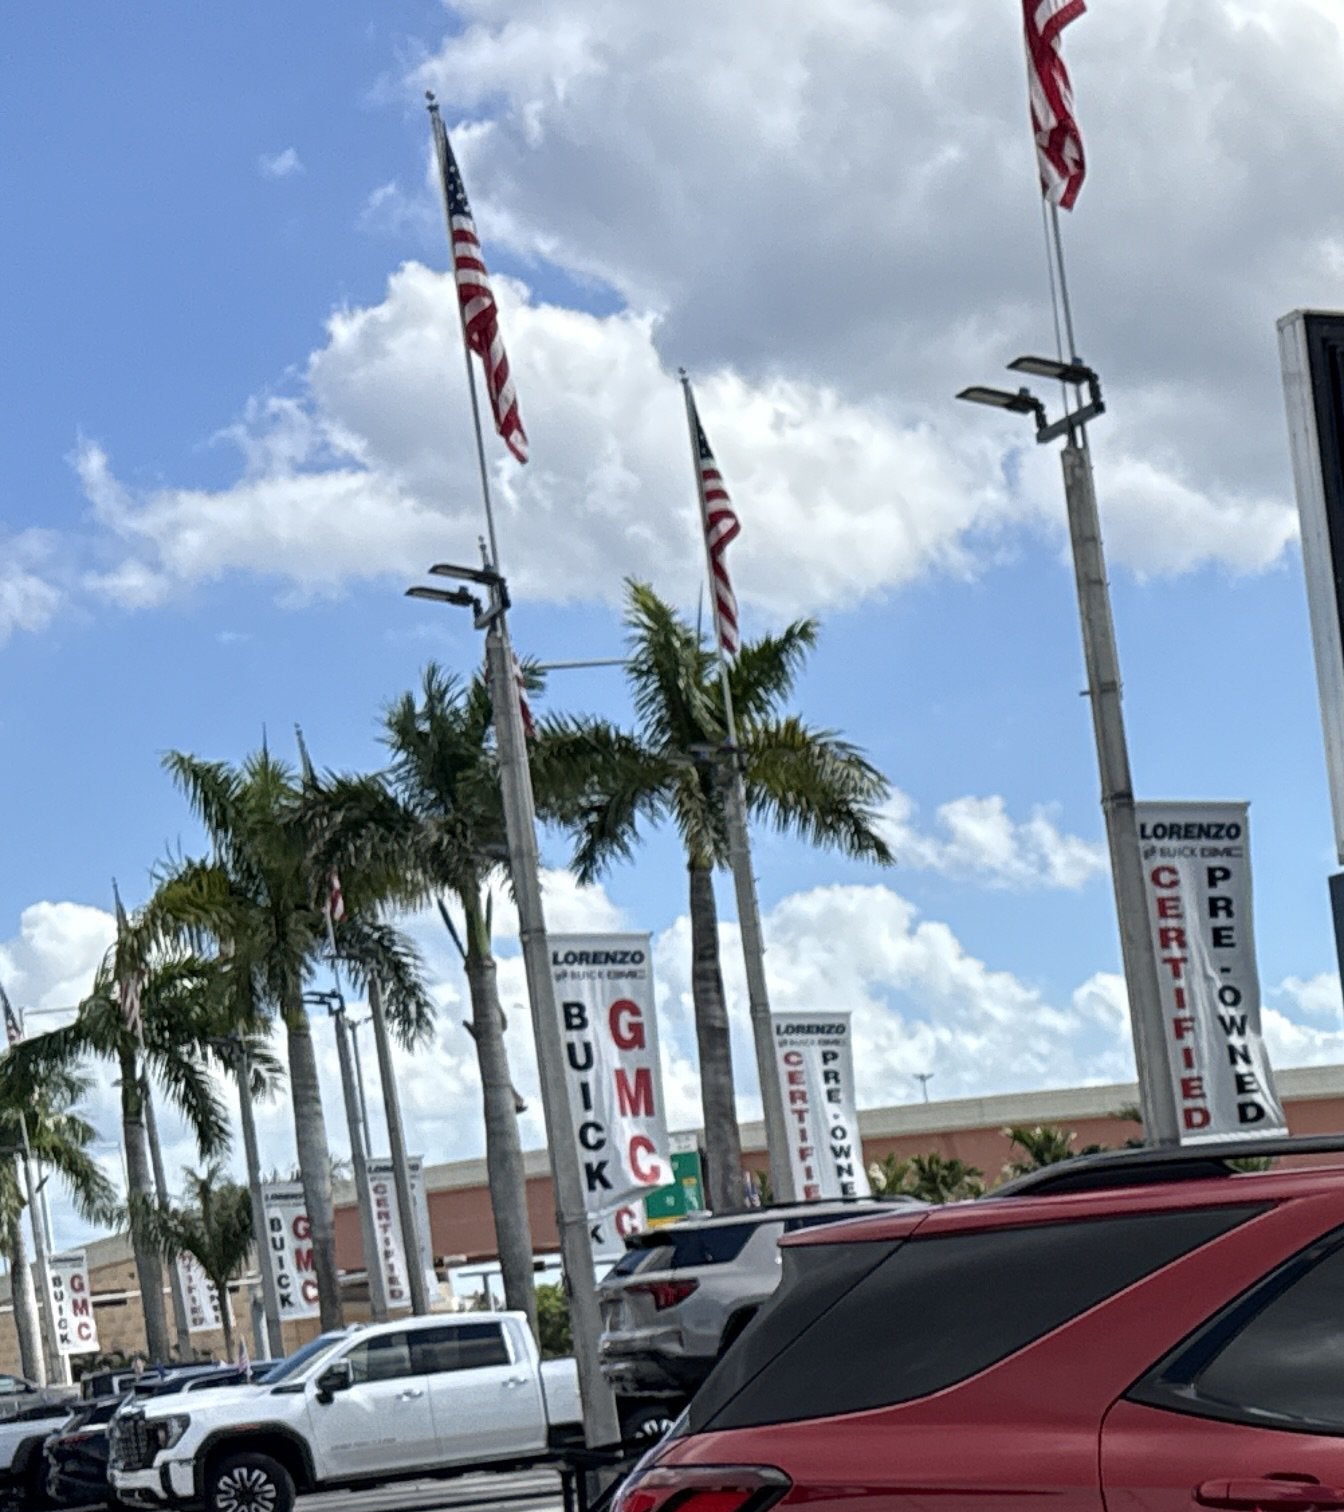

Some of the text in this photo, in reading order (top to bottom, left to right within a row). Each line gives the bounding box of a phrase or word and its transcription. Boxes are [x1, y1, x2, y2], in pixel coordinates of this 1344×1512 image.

[1139, 822, 1242, 841] LORENZO
[552, 950, 645, 967] LORENZO
[1151, 865, 1211, 1130] CERTIFIED
[776, 1023, 846, 1036] LORENZO
[561, 1001, 613, 1192] BUICK
[608, 998, 661, 1185] GMC
[784, 1051, 821, 1200] CERTIFIE
[822, 1051, 857, 1201] PRE-OWNE
[269, 1217, 294, 1309] BUICK
[292, 1215, 319, 1306] GMC
[69, 1273, 92, 1341] GMC
